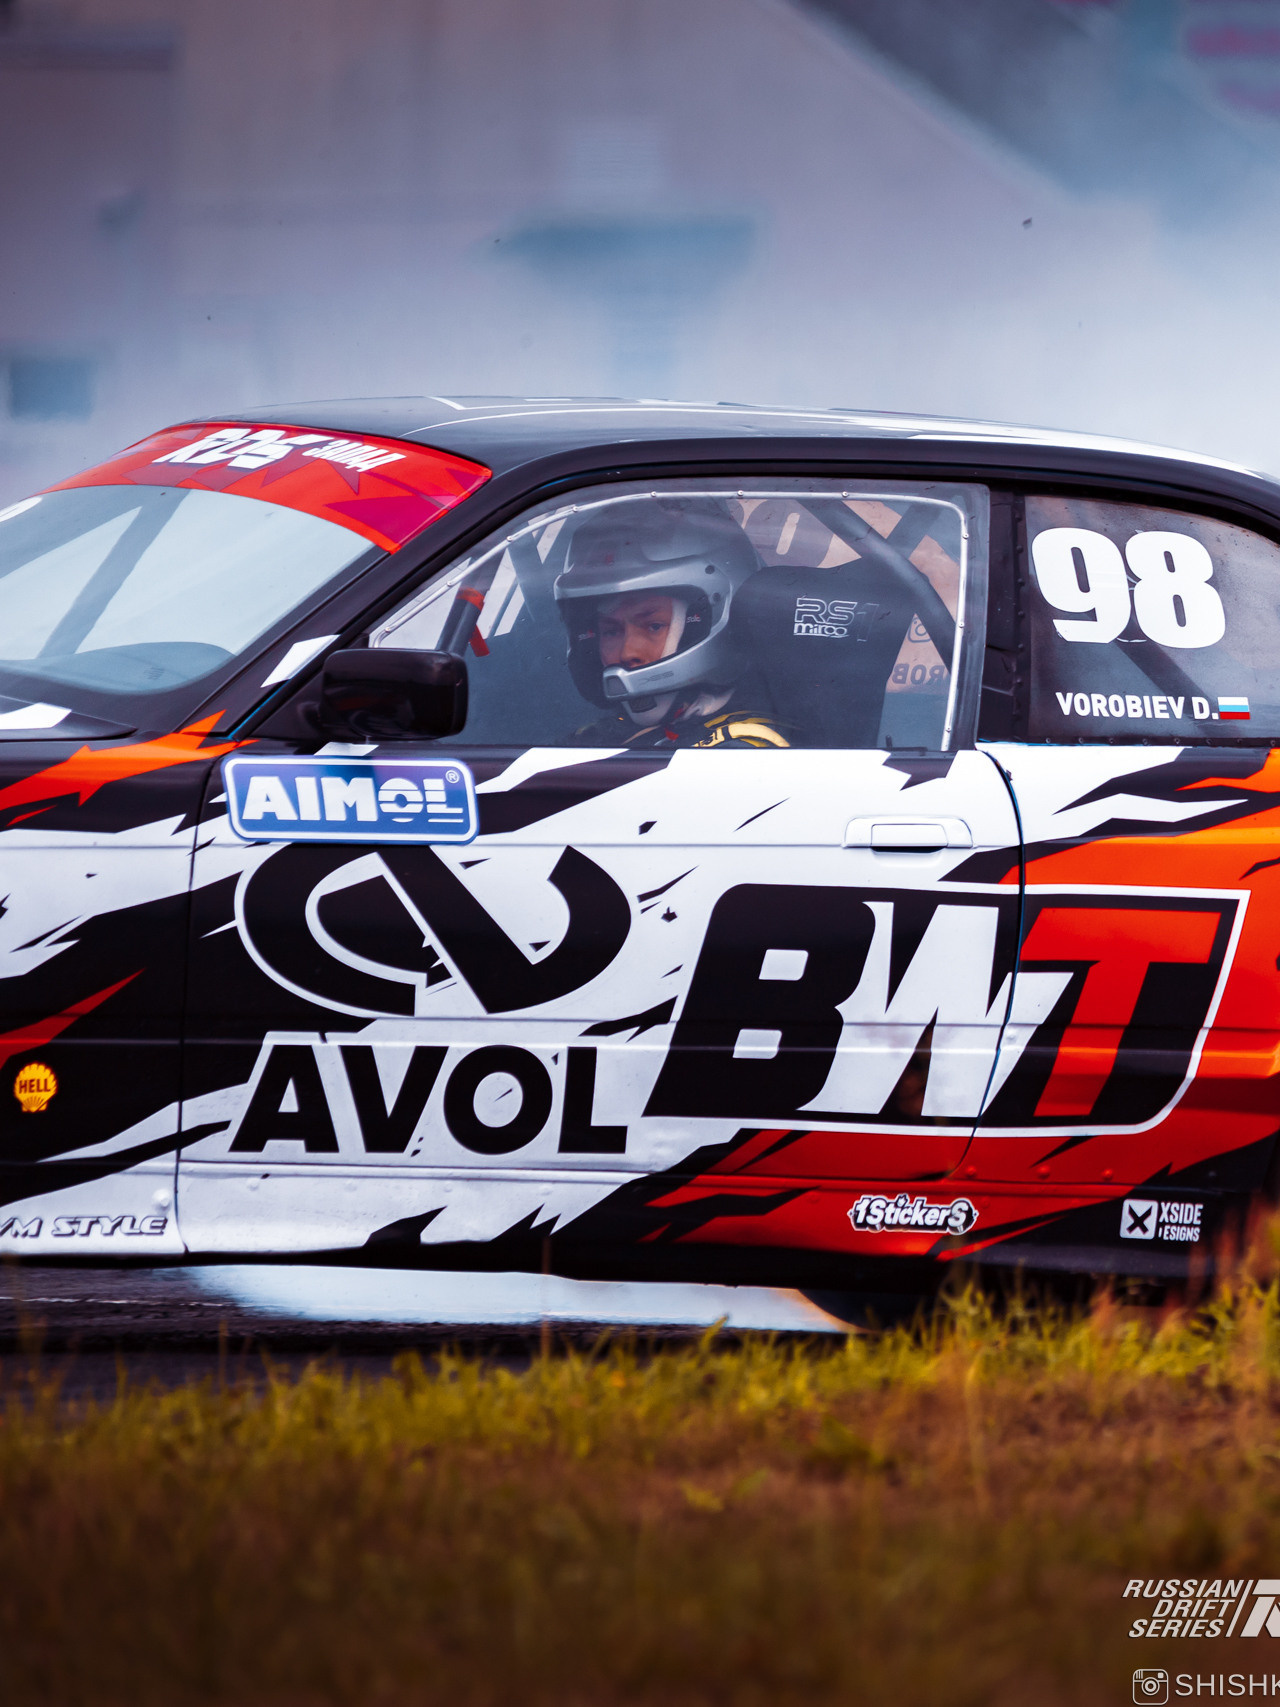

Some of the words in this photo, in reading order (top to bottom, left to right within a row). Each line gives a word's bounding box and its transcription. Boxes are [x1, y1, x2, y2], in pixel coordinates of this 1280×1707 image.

[1032, 527, 1226, 648] 98
[1056, 692, 1185, 719] VOROBIEV
[1191, 697, 1219, 720] D.
[641, 886, 1222, 1120] BWT
[19, 1079, 51, 1094] HELL
[228, 1044, 628, 1155] AVOL
[51, 1215, 168, 1237] STYLE
[1159, 1202, 1204, 1225] XSIDE
